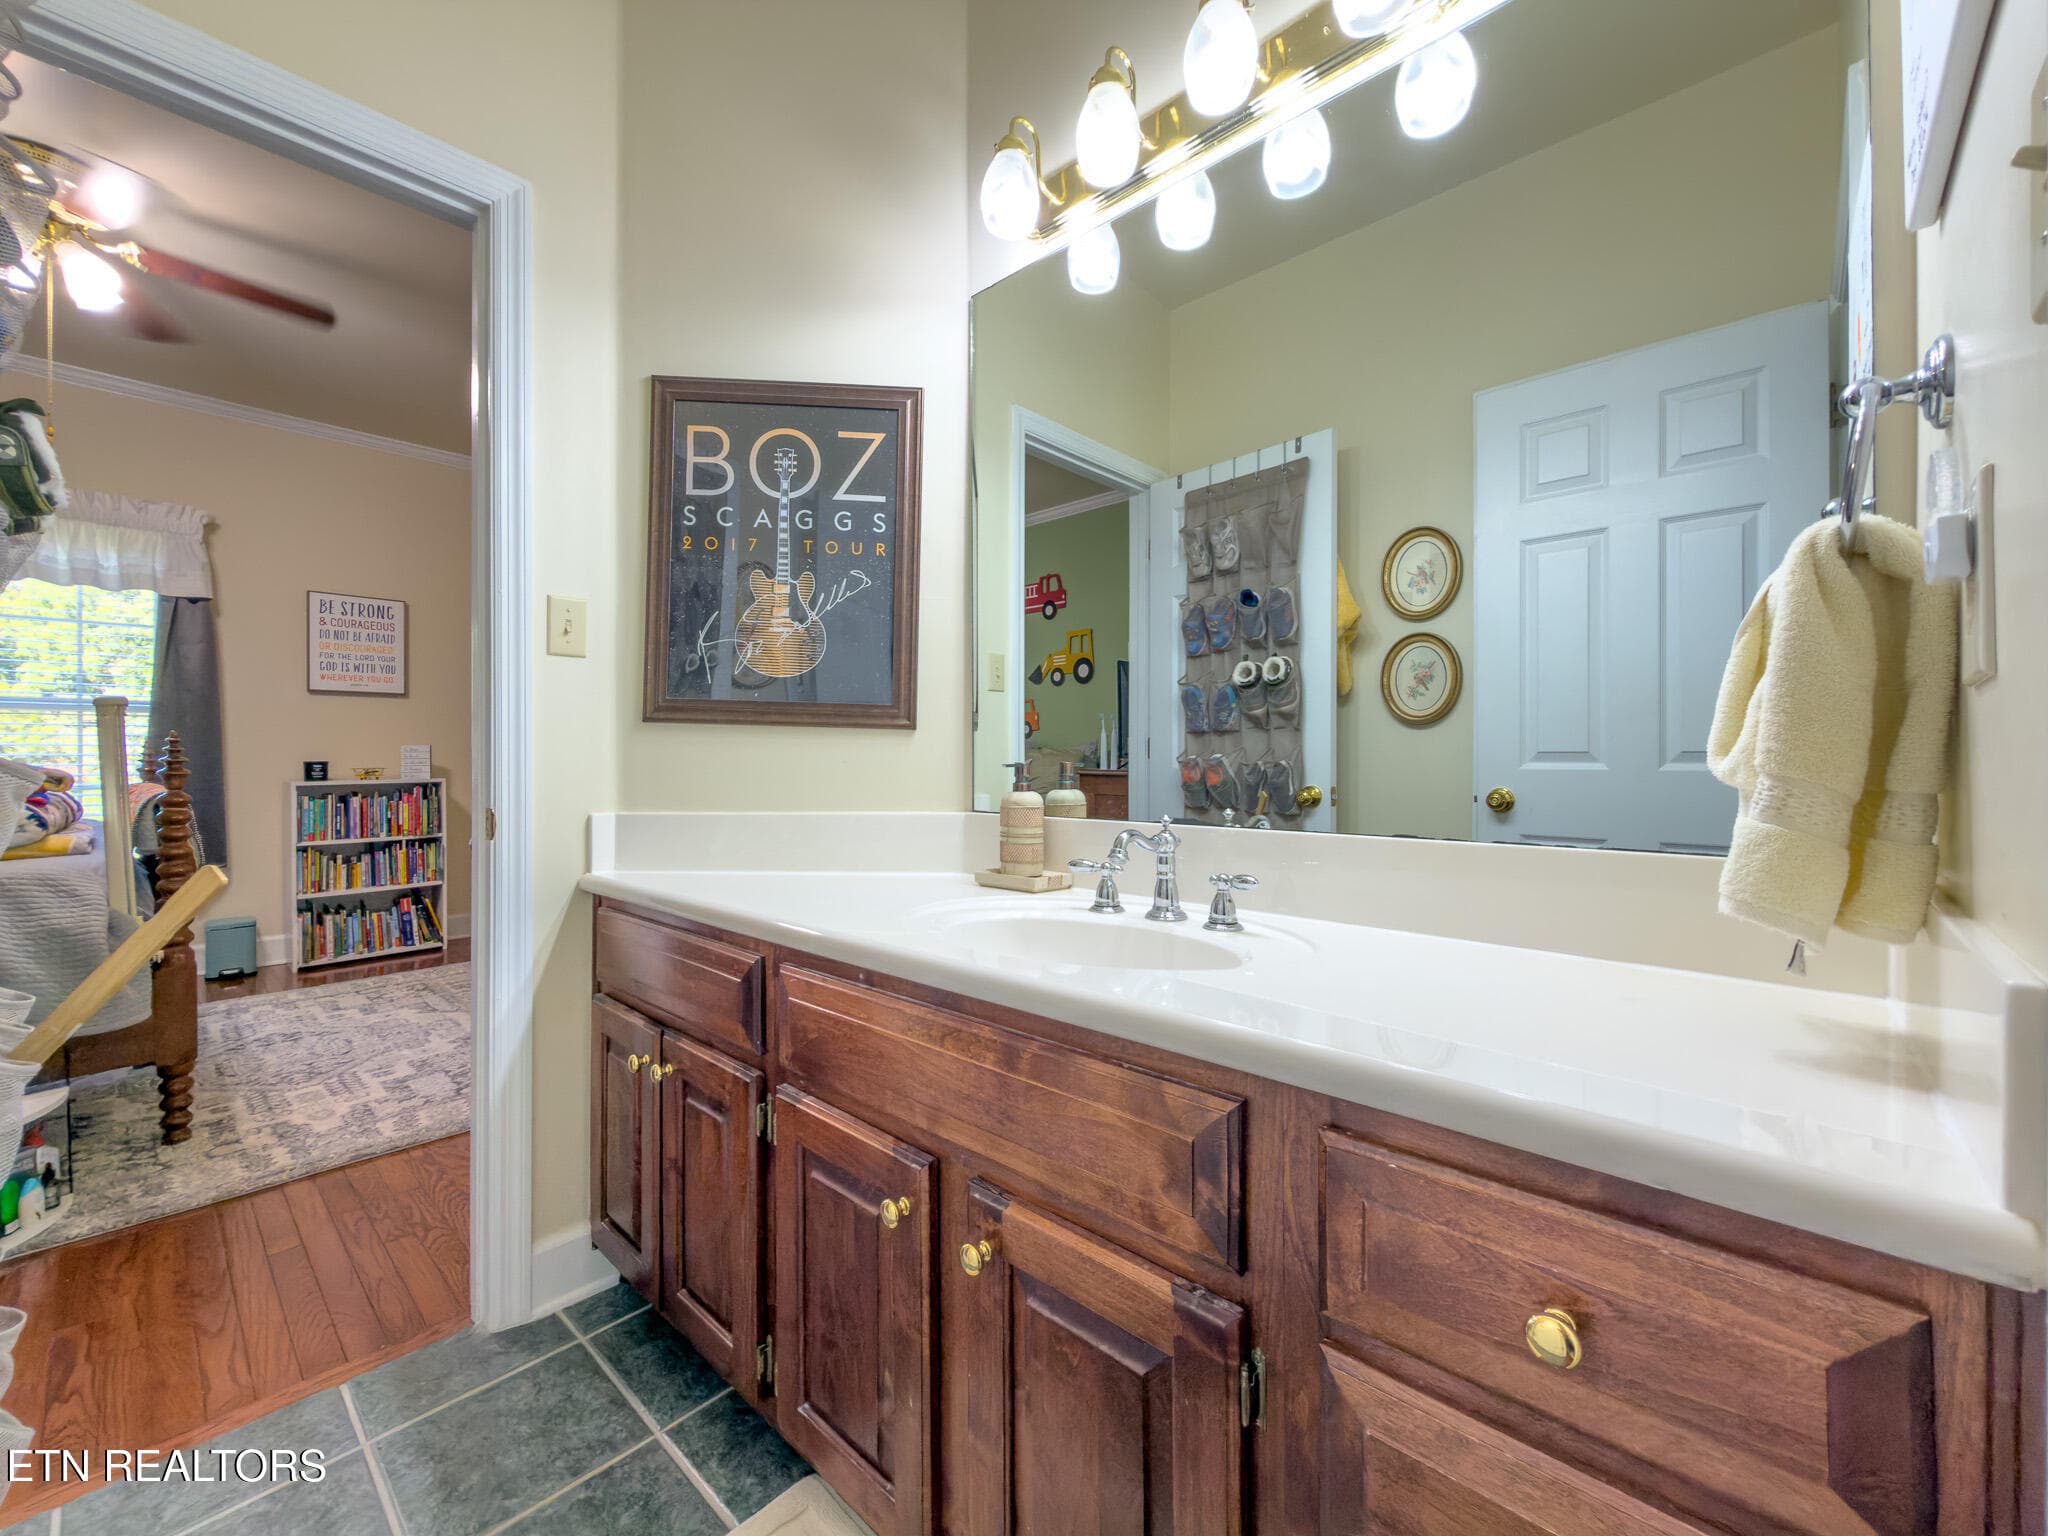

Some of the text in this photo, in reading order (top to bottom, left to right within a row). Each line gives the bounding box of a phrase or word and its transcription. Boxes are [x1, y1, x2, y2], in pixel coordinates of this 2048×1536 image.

[685, 425, 887, 503] BOZ
[683, 506, 887, 533] SCAGGS
[682, 536, 886, 556] 2017 TOUR
[320, 599, 395, 620] BE STRONG
[330, 618, 396, 632] COURAGEOUS
[319, 629, 396, 644] DO NOT BE AFRAID
[319, 652, 335, 660] FOR
[338, 653, 352, 661] THE
[355, 654, 375, 662] LORD
[319, 661, 396, 675] GOD IS WITH YOU
[320, 673, 364, 682] WHEREVER
